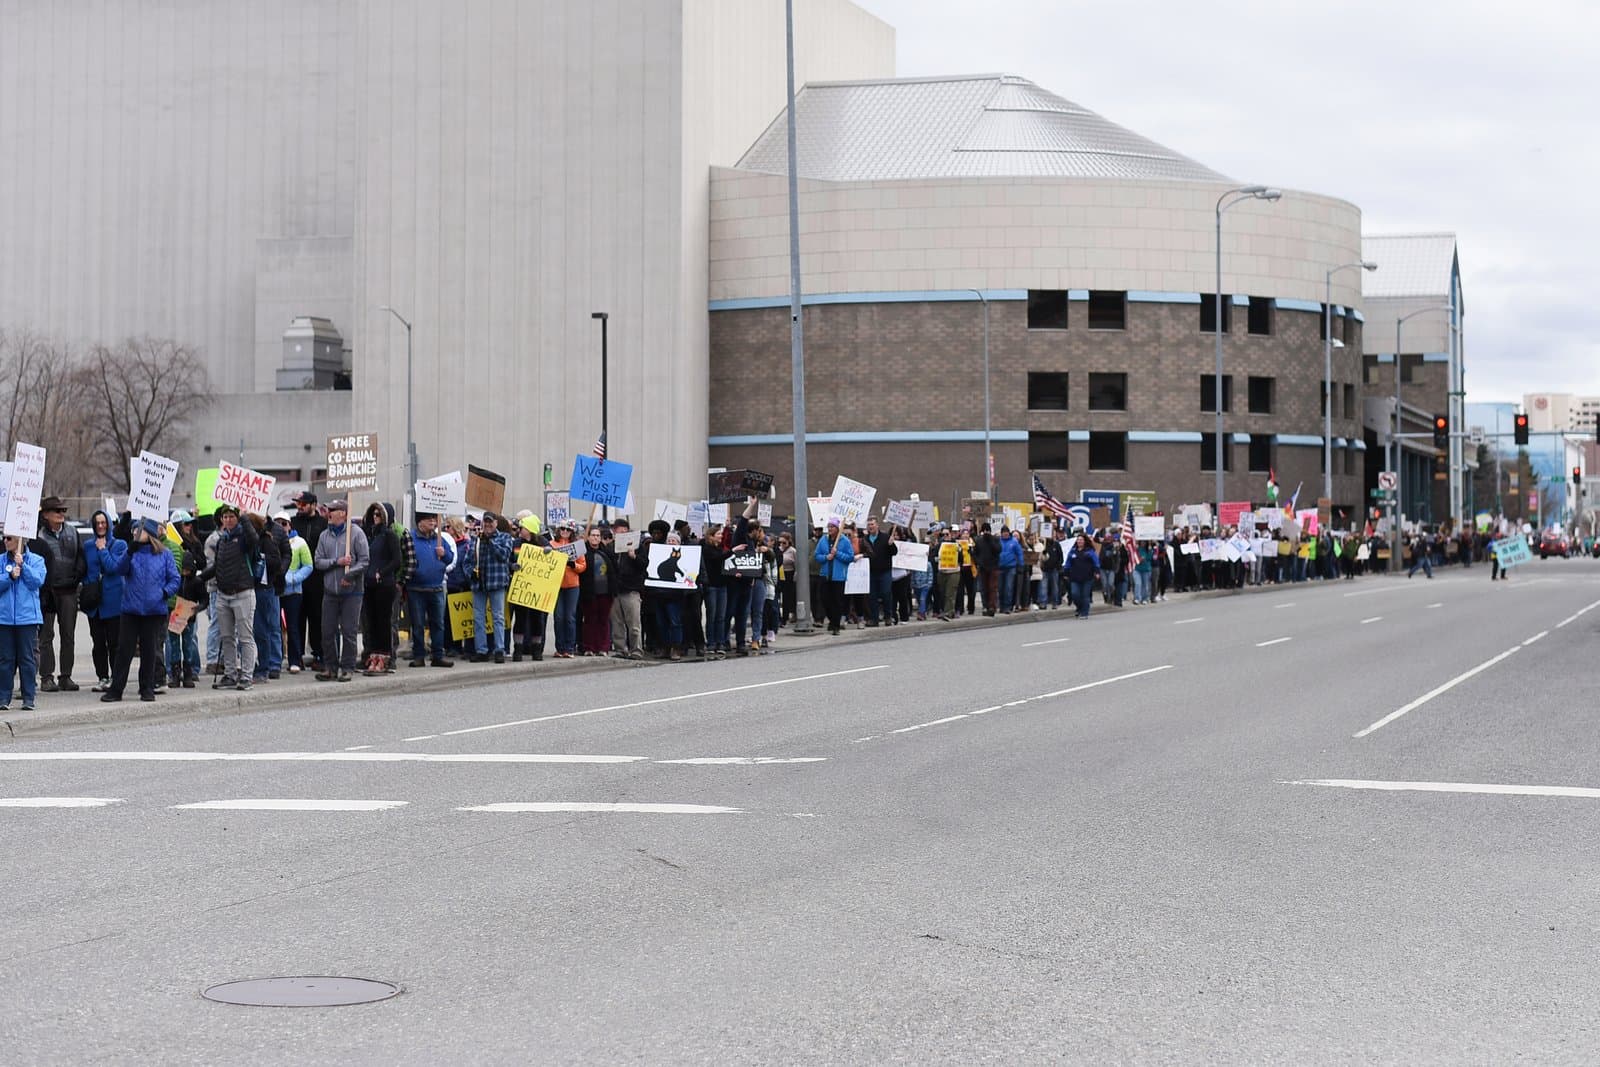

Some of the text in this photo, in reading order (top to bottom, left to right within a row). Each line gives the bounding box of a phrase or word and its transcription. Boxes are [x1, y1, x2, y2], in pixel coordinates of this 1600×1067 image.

[331, 435, 370, 449] THREE
[141, 456, 176, 473] My father
[327, 449, 377, 465] CO-EQUAL
[144, 468, 166, 480] didn't
[328, 461, 377, 478] BRANCHES
[579, 457, 605, 479] We
[144, 478, 162, 489] fight
[220, 464, 273, 496] SHAME
[582, 477, 621, 495] MUST
[134, 496, 145, 505] for
[140, 488, 159, 501] Nazis
[214, 484, 265, 513] COUNTRY
[582, 490, 622, 506] FIGHT
[523, 546, 558, 571] Nobody
[520, 560, 552, 580] Voted
[514, 574, 531, 589] For
[509, 587, 541, 607] ELON
